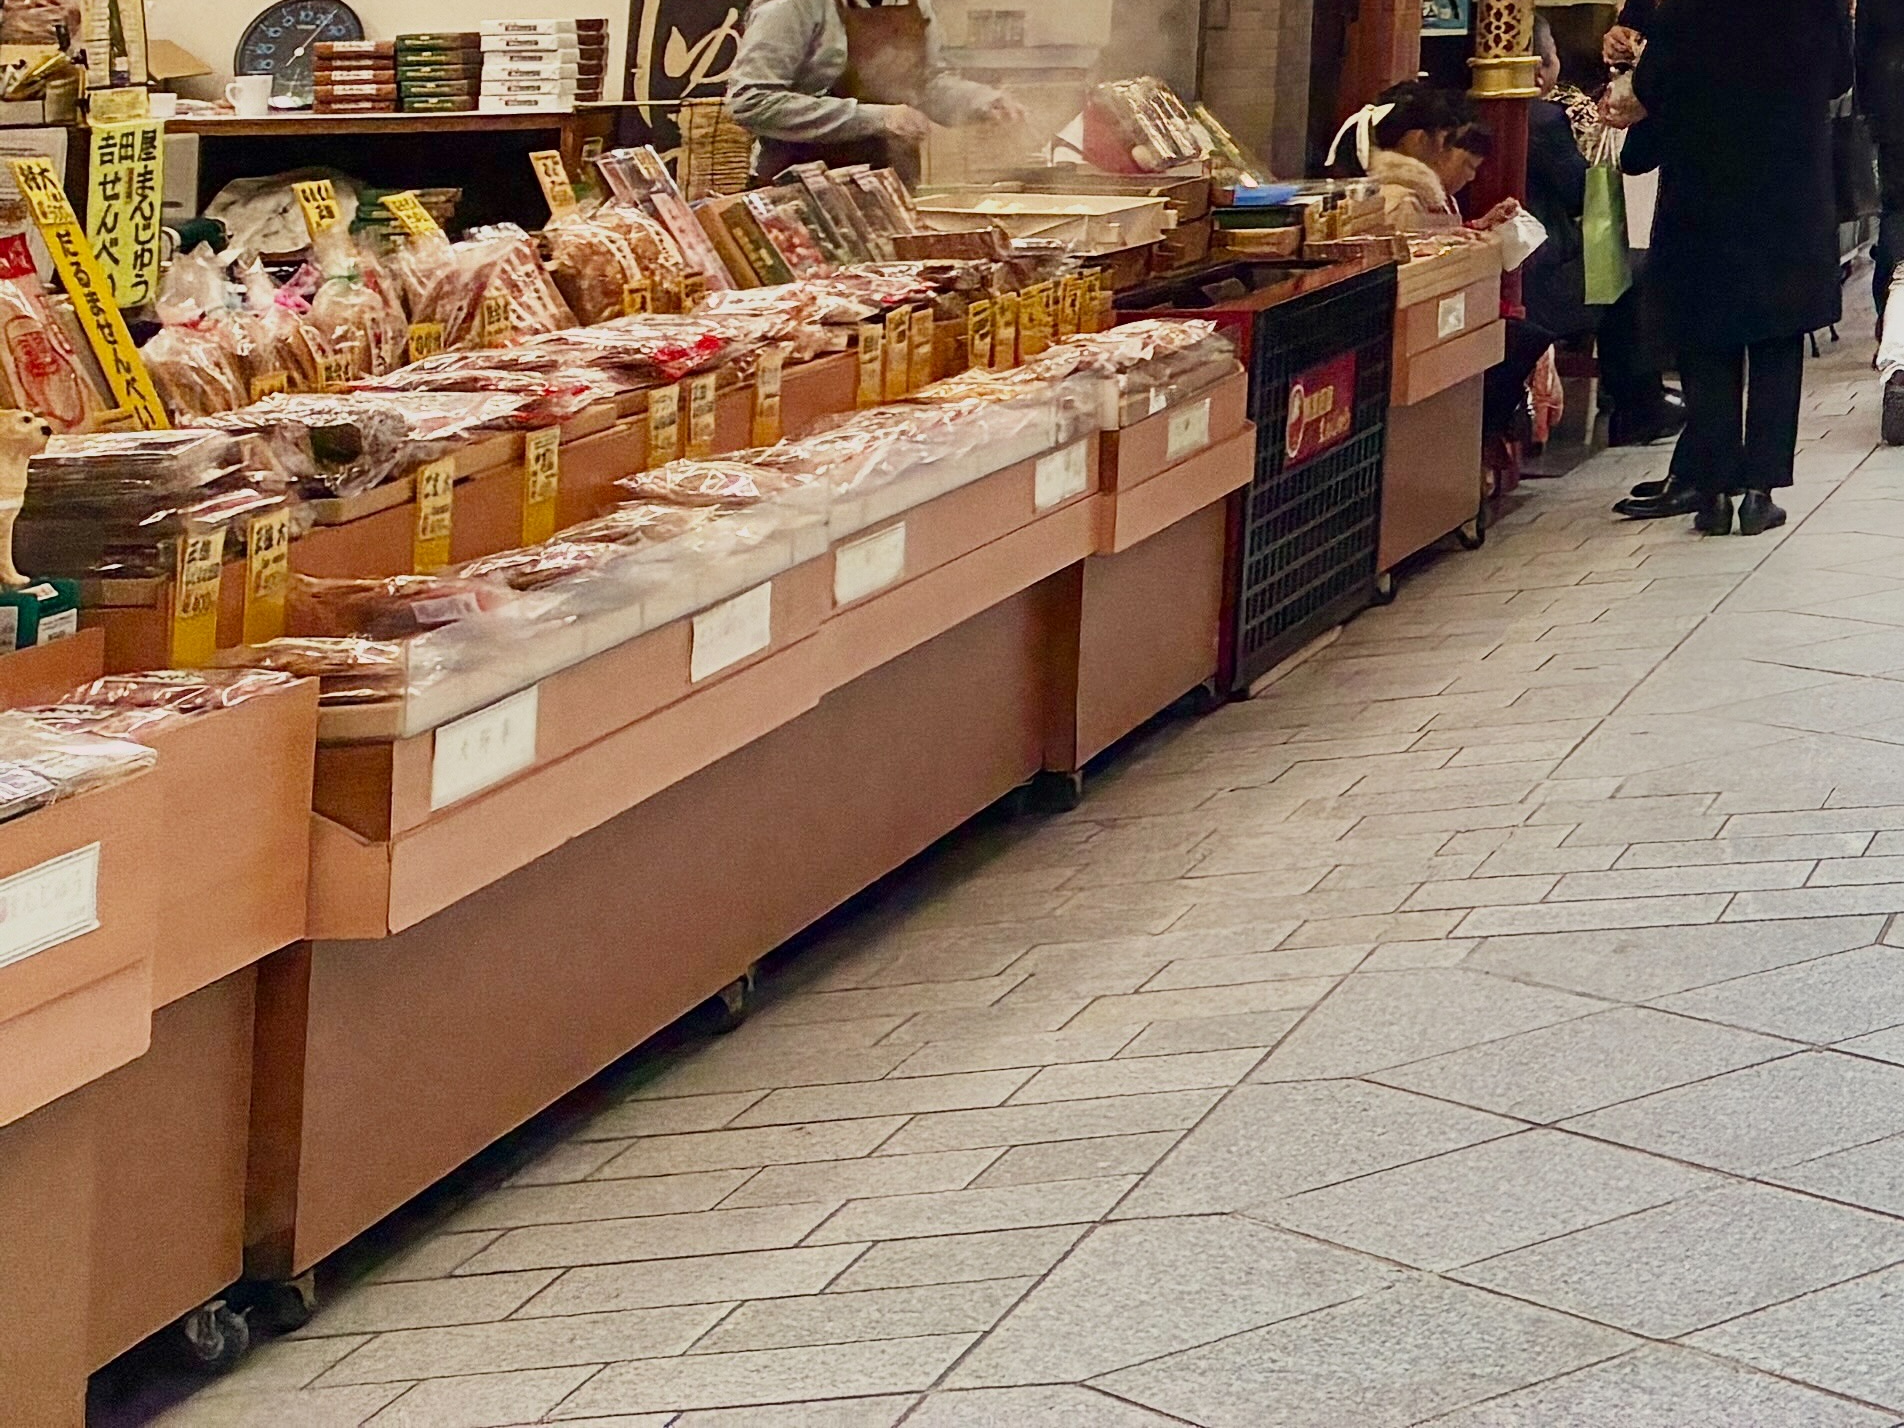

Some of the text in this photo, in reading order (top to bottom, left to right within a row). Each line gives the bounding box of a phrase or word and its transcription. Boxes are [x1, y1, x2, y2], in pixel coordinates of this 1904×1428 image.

[129, 166, 156, 305] まんじゅう
